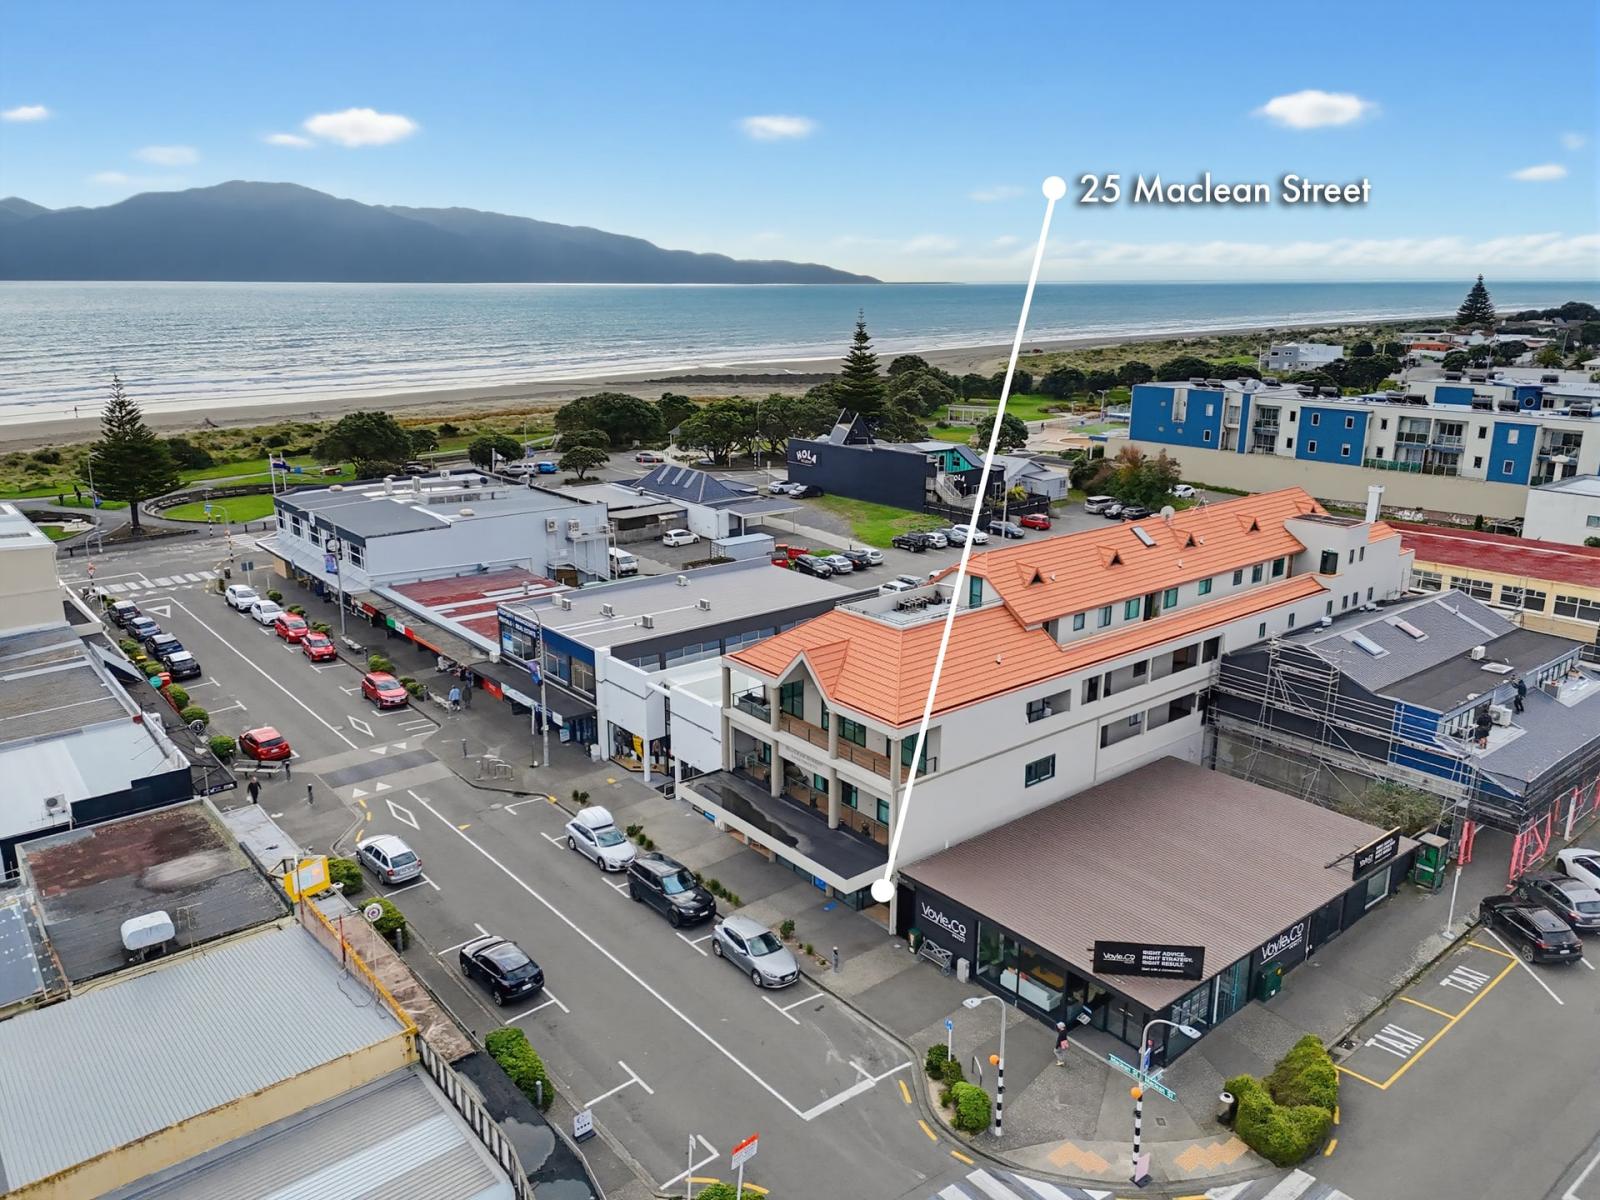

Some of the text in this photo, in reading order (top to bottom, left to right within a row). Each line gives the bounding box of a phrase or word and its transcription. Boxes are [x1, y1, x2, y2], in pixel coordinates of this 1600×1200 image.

[796, 449, 817, 464] HOLA
[921, 901, 967, 937] Voyle.Co
[1261, 922, 1304, 960] Voyle.Co
[1440, 965, 1490, 994] TAXI
[1365, 1023, 1424, 1059] TAXI
